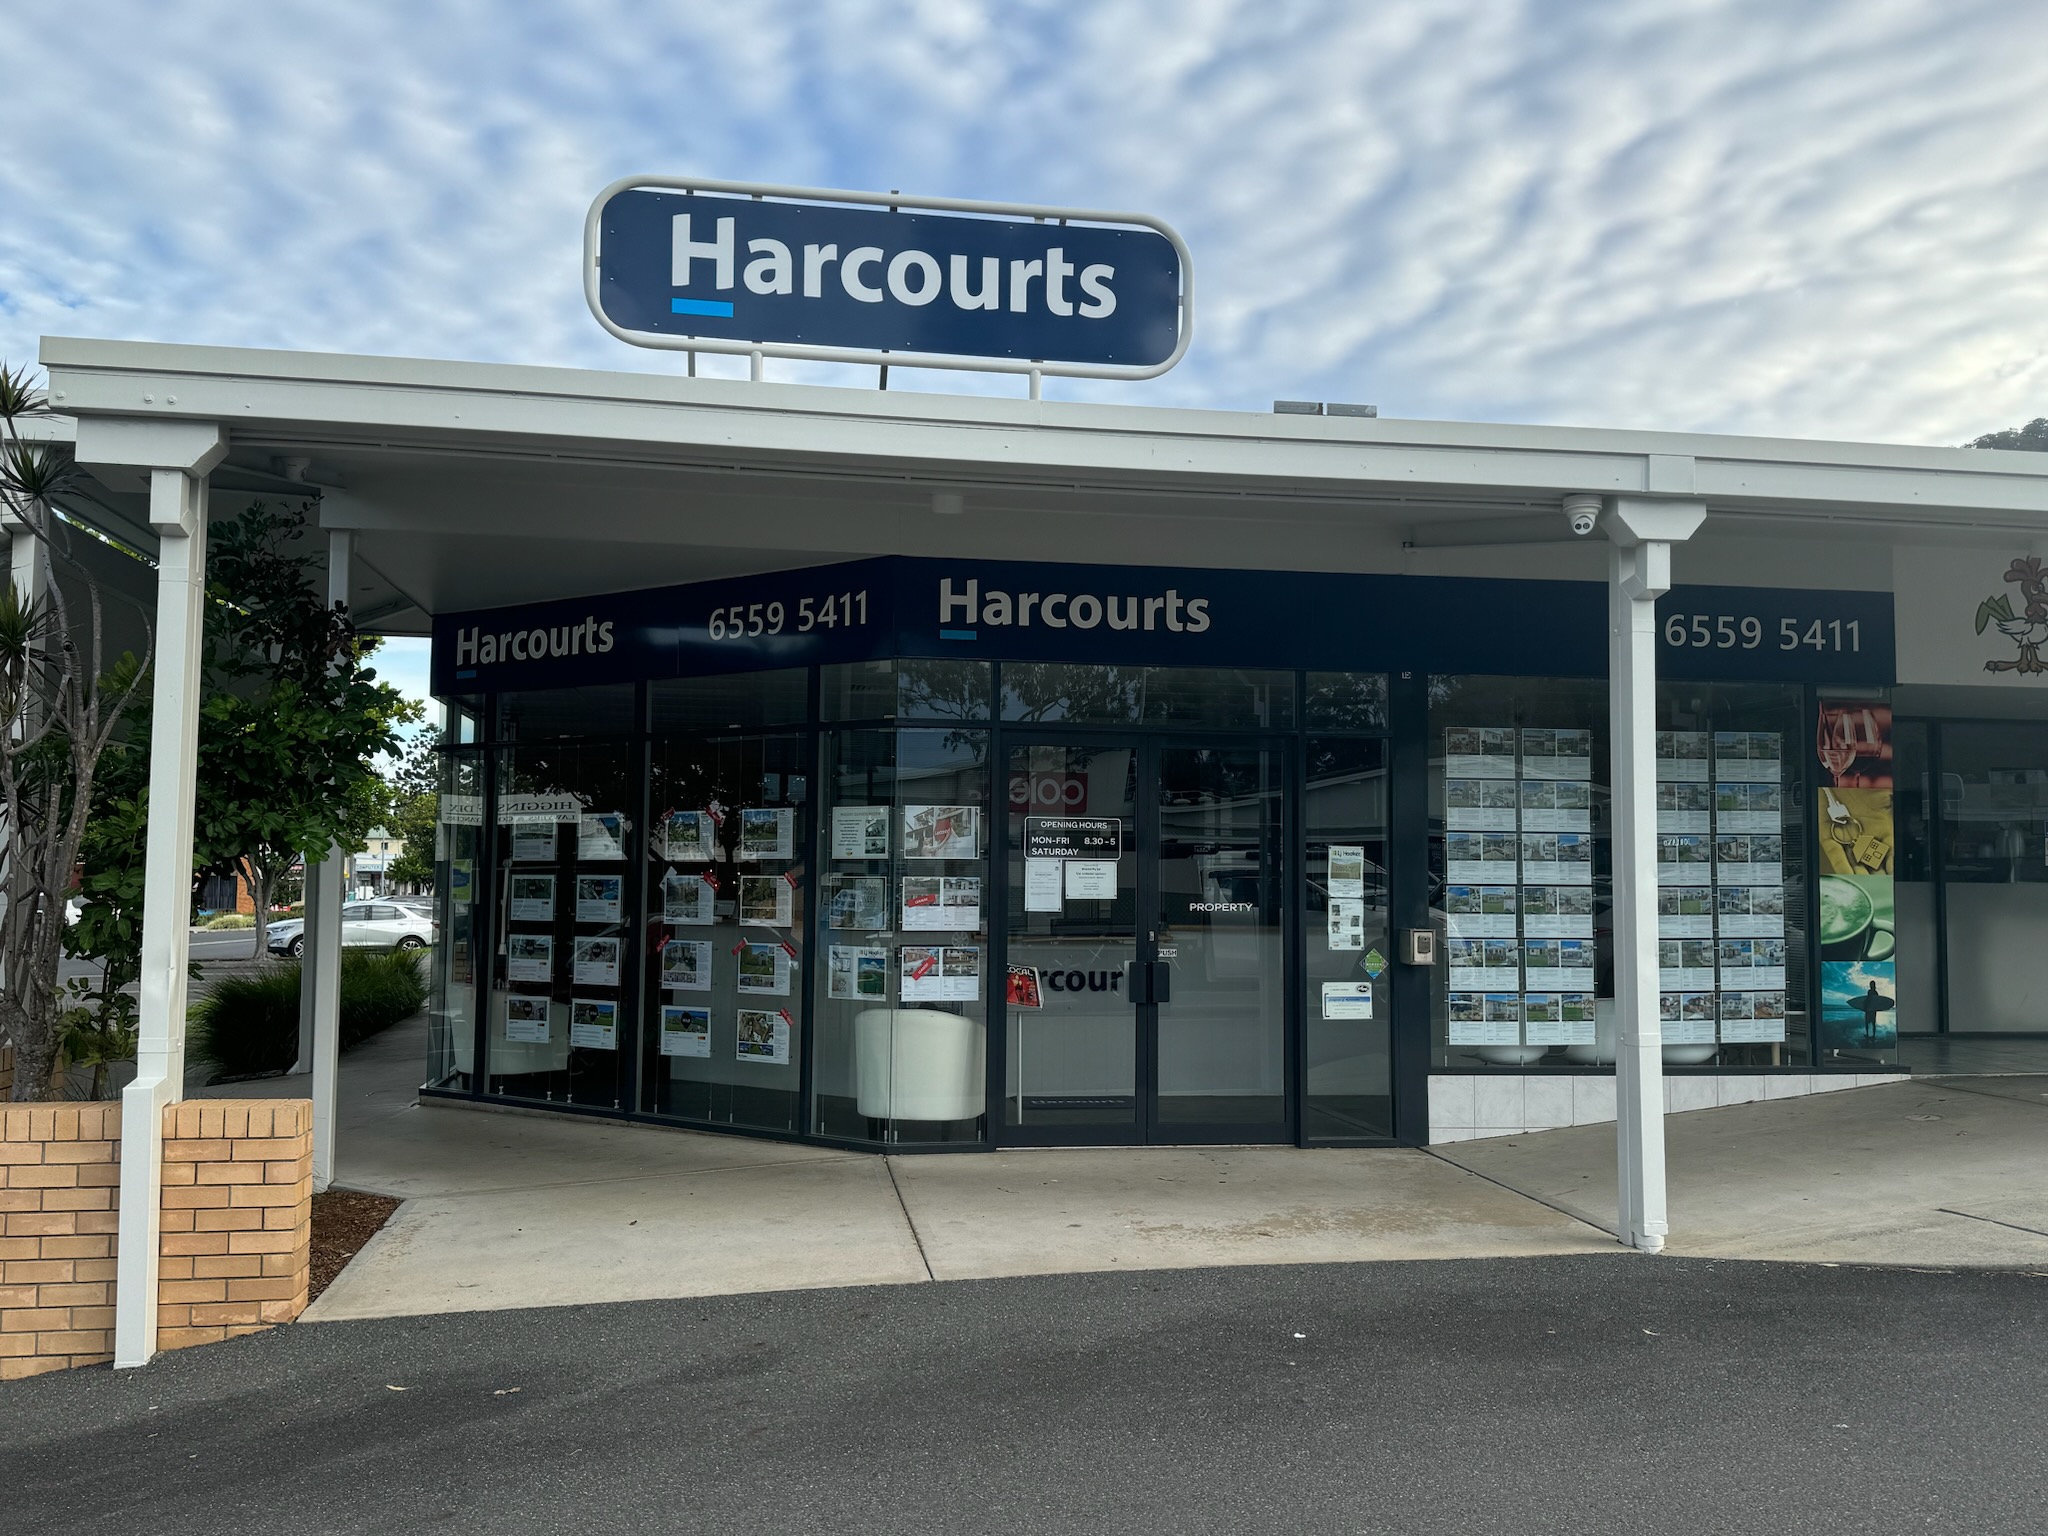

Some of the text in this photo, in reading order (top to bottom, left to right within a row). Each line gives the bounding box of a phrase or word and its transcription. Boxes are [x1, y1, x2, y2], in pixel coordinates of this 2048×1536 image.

[670, 212, 1118, 320] Harcourts
[708, 589, 867, 642] 6559 5411
[939, 577, 1211, 633] Harcourts
[455, 615, 615, 667] Harcourts
[1664, 613, 1861, 653] 6559 5411
[1031, 836, 1070, 845] MON-FRI
[1040, 821, 1108, 830] OPENING HOURS
[1031, 848, 1079, 856] SATURDAY
[1189, 902, 1253, 912] PROPERTY
[1038, 970, 1125, 992] rcour
